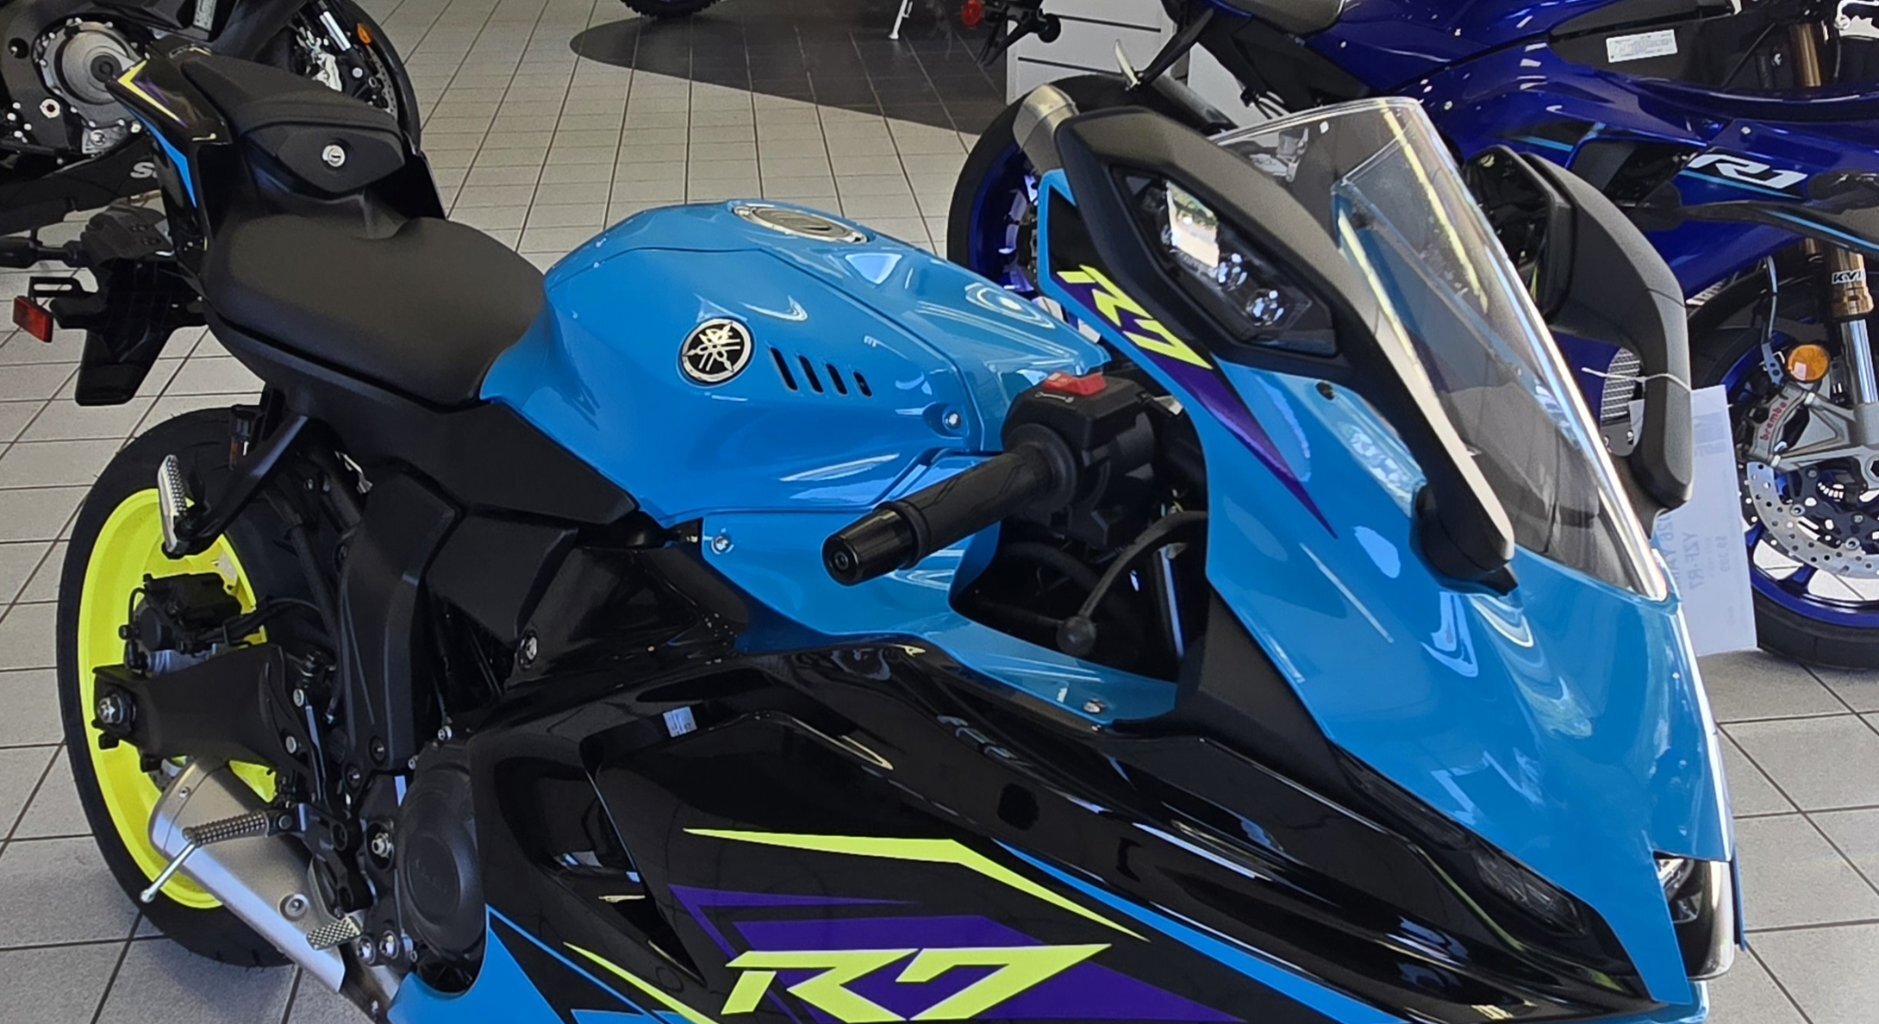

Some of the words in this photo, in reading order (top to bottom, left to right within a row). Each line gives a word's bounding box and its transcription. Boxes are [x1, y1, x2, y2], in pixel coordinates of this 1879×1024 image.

[1687, 154, 1808, 189] R1
[1056, 264, 1213, 370] R7
[1760, 401, 1787, 441] brembo
[721, 944, 1112, 1023] R7
